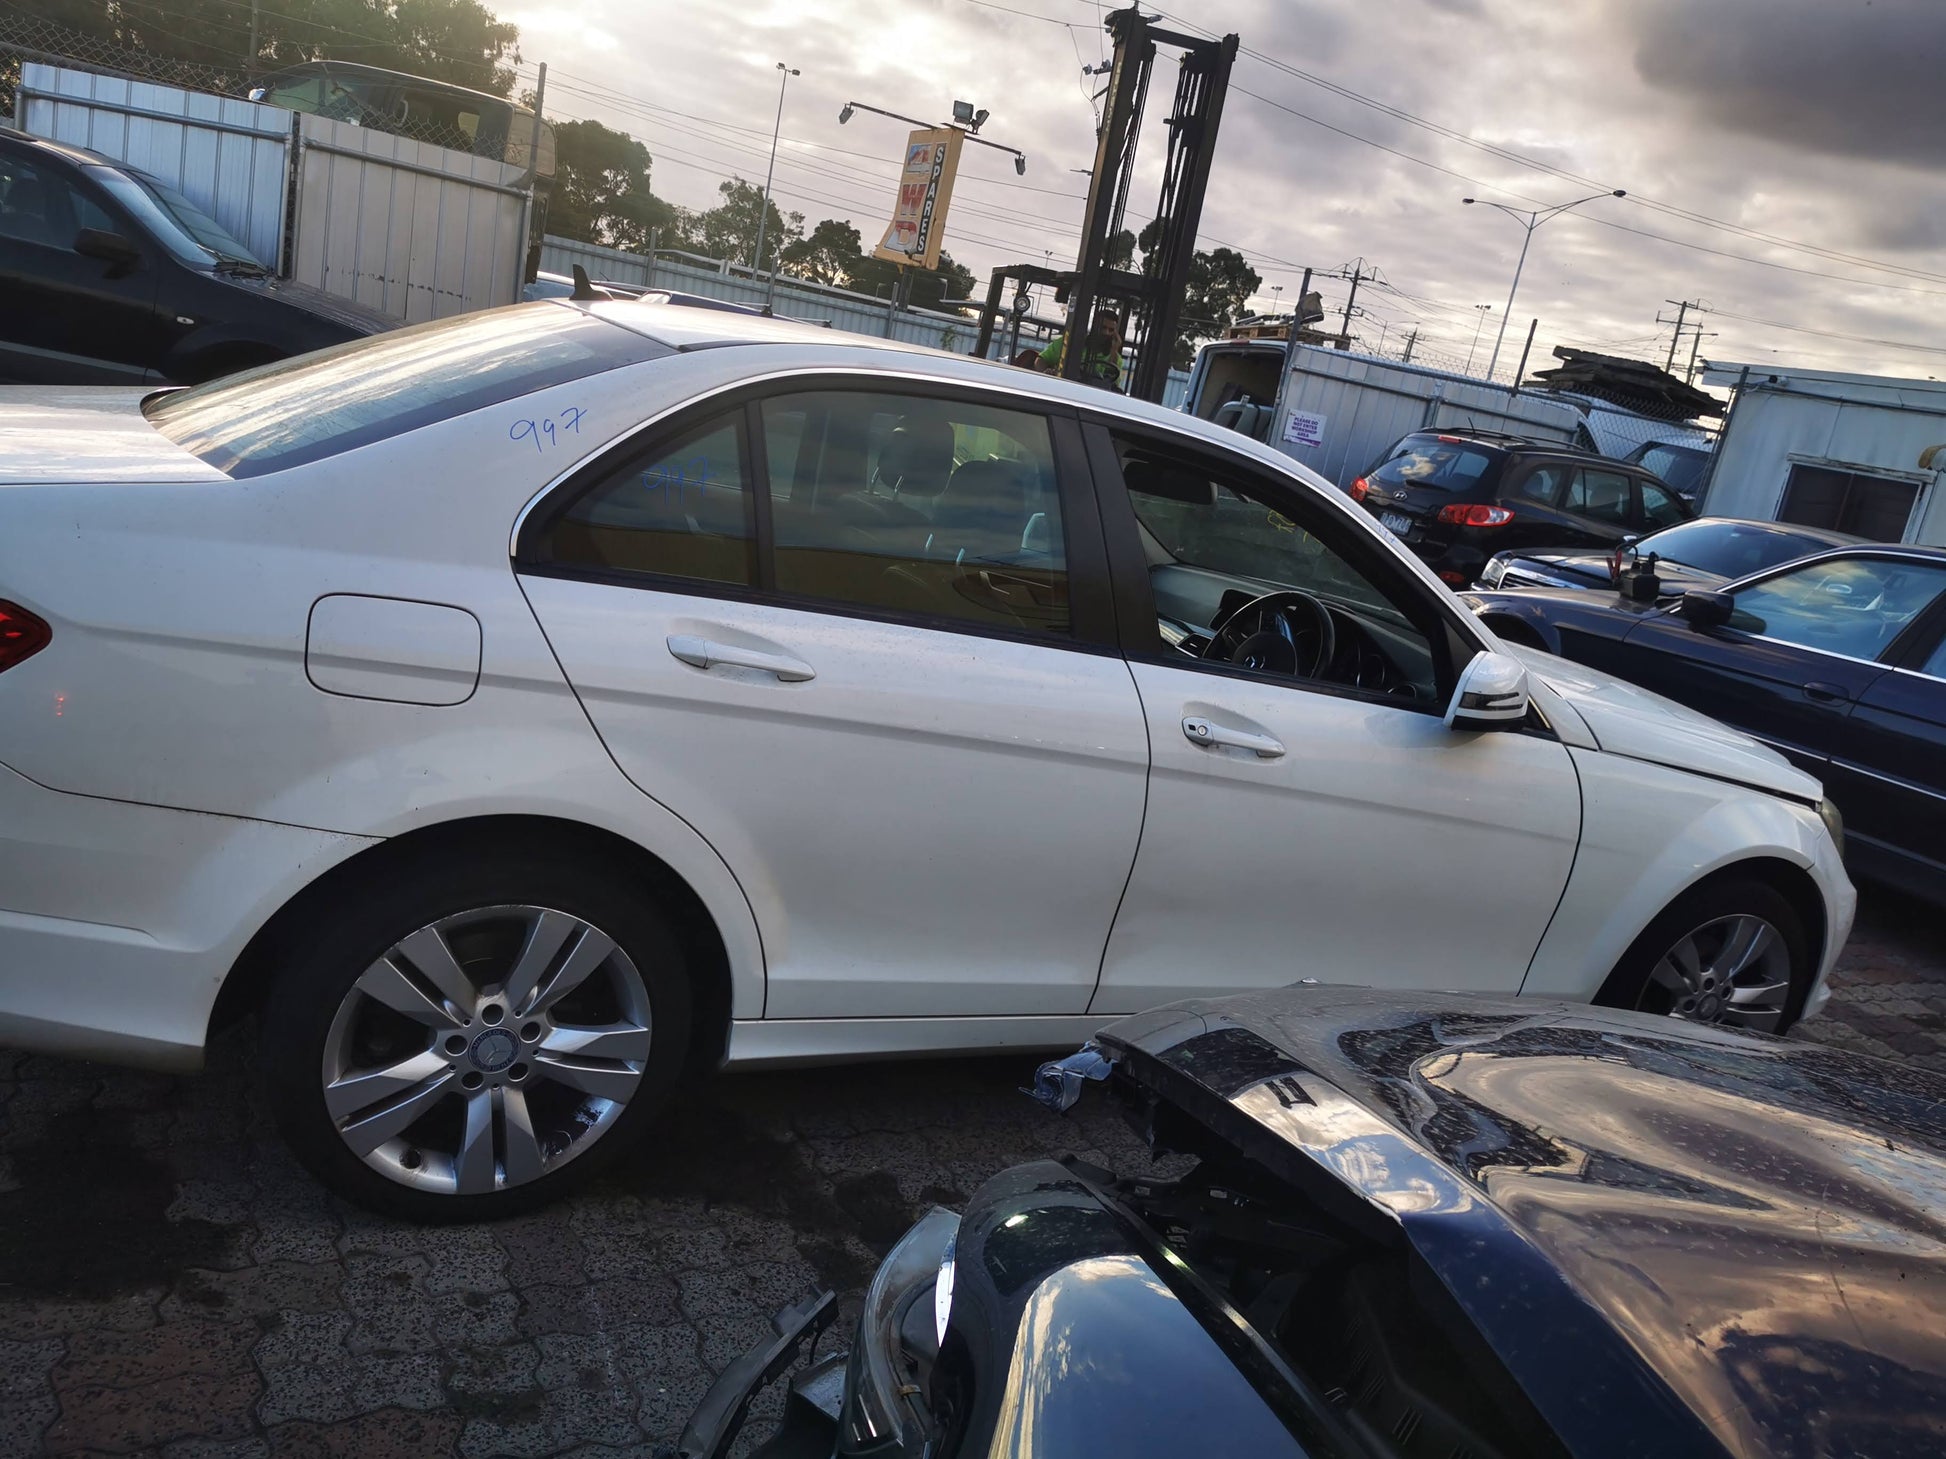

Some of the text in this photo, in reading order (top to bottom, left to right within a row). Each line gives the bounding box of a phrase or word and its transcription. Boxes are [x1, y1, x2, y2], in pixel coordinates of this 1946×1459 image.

[917, 146, 946, 252] SPARES
[509, 407, 588, 453] 997
[1291, 426, 1318, 434] WORKSHOP
